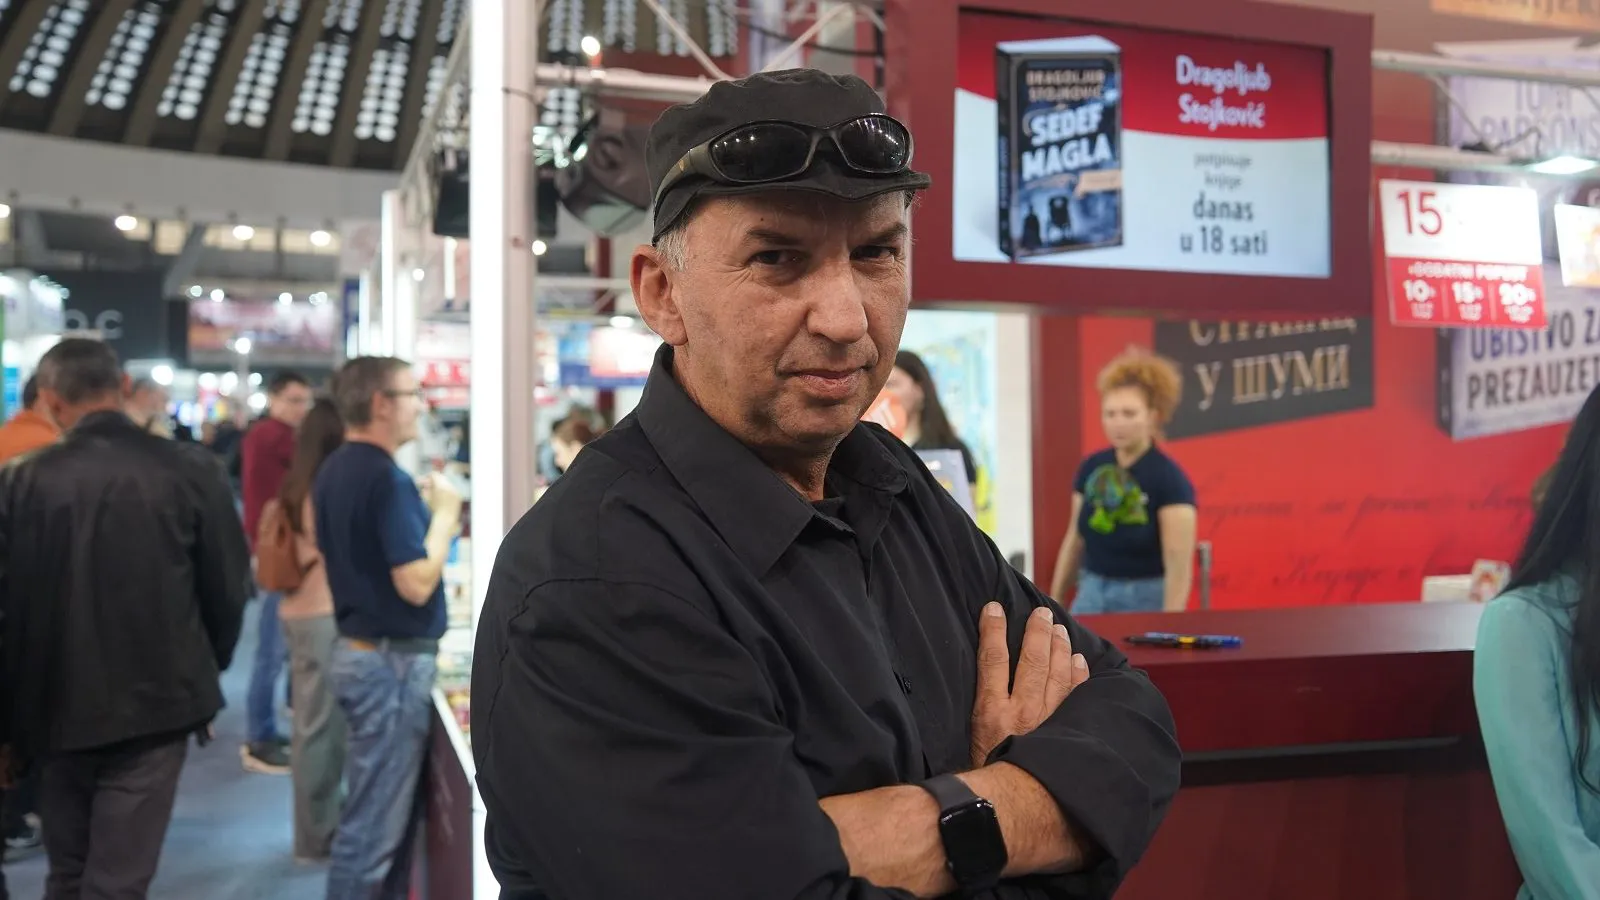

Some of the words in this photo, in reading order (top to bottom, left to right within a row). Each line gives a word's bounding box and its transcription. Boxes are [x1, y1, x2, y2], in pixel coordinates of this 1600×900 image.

[1175, 54, 1272, 96] Dragoljub
[1030, 102, 1104, 147] SEDEF
[1178, 93, 1266, 131] Stojković
[1022, 133, 1114, 181] MAGLA
[1193, 191, 1254, 222] danas
[1397, 189, 1443, 236] 15
[1180, 232, 1193, 252] u
[1200, 225, 1223, 254] 18
[1230, 230, 1268, 255] sati
[1584, 307, 1600, 346] Z
